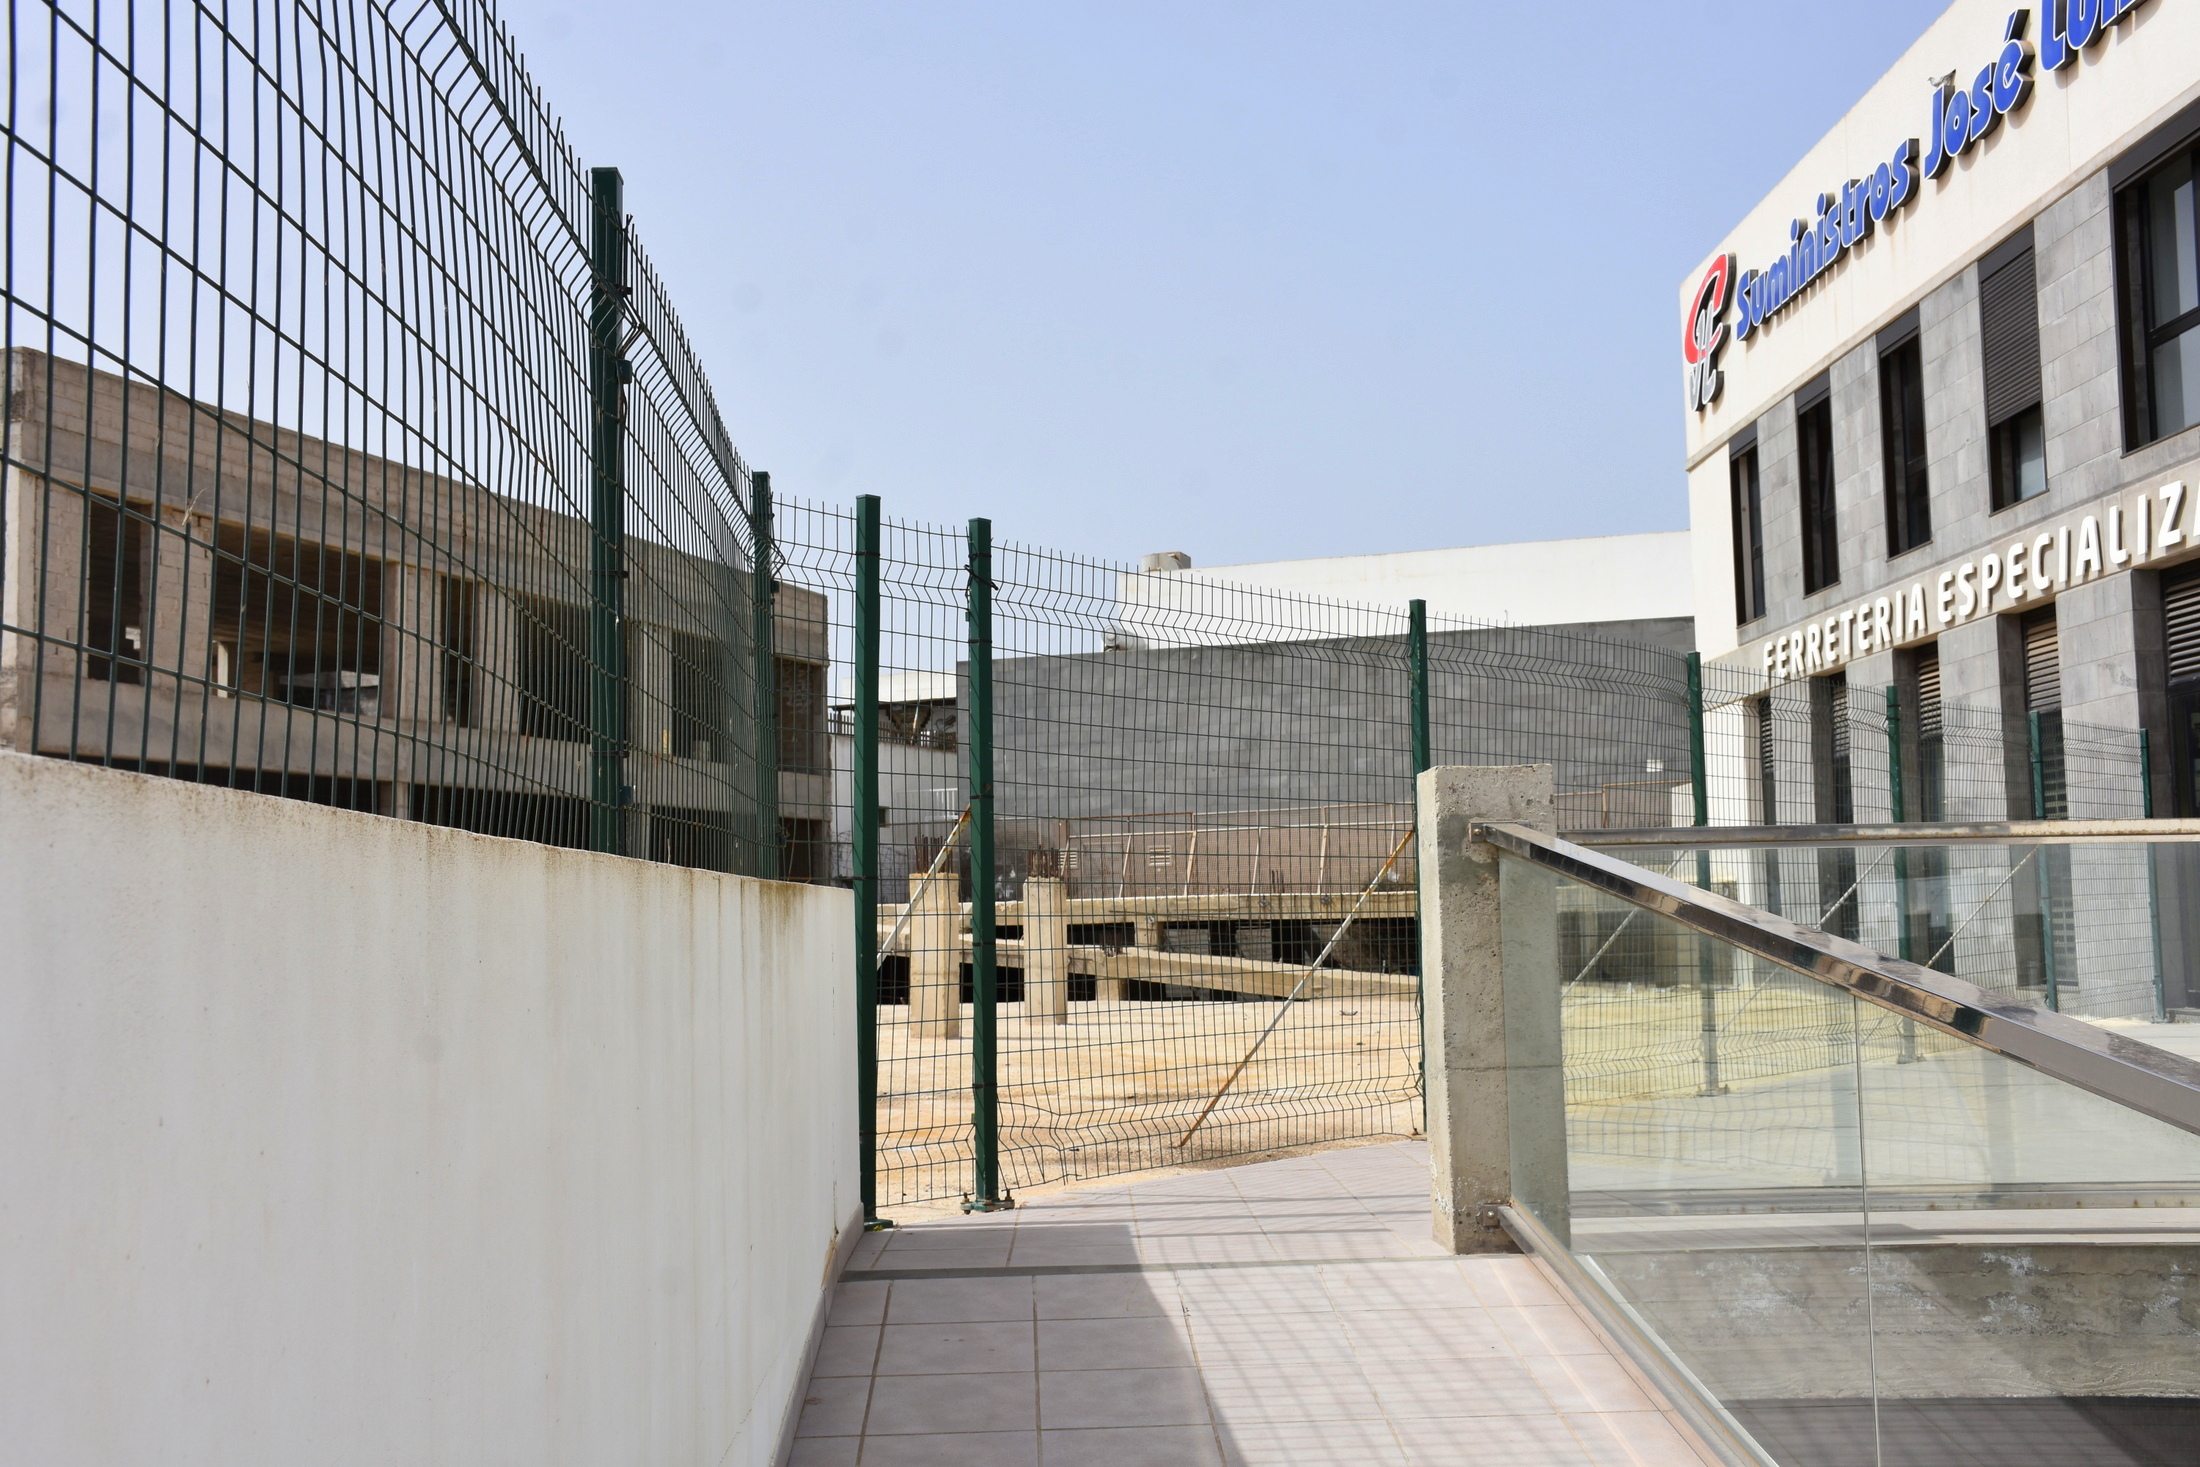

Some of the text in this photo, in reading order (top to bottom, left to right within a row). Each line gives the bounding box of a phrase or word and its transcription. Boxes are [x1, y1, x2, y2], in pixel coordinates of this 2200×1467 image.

[1736, 138, 1913, 341] Suministros
[1924, 9, 2029, 180] José
[1763, 479, 2200, 683] FERRETERIA ESPECIALIZ
